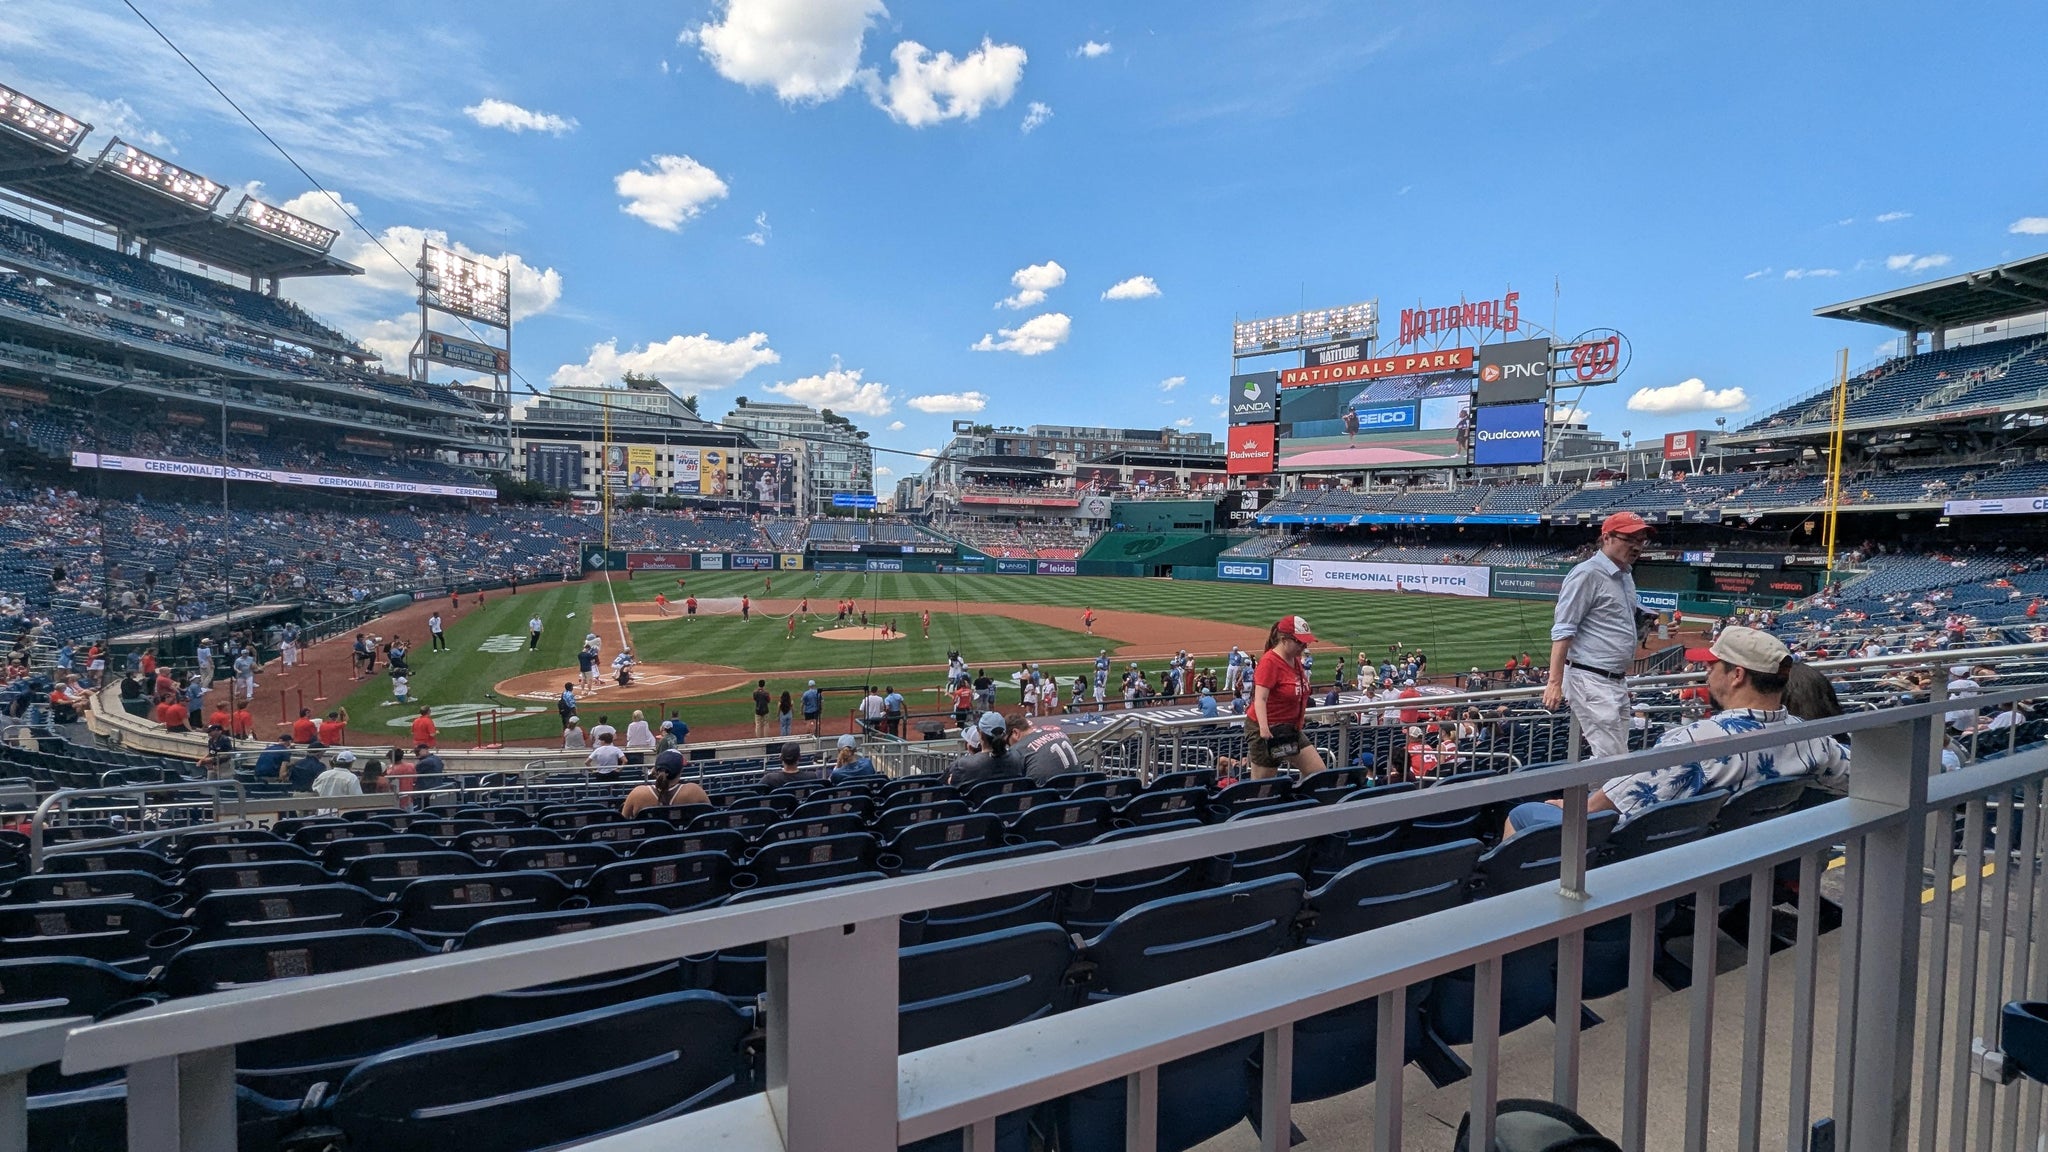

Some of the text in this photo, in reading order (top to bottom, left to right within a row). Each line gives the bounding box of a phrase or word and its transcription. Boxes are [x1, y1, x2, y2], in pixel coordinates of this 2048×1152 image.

[1400, 291, 1519, 345] NATIONALS
[1320, 345, 1360, 364] NATITUDE
[1287, 353, 1460, 383] NATIONALS PARK
[1503, 362, 1545, 379] PNC
[1233, 402, 1271, 412] VANDA
[1478, 429, 1541, 441] Qualcomm
[1230, 450, 1270, 459] Budweiser
[145, 461, 272, 481] CEREMONIAL FIRST PITCH
[318, 477, 417, 492] CEREMONIAL FIRST PITCH
[455, 487, 497, 497] CEREMONIAL
[746, 556, 769, 564] Inova
[879, 561, 900, 570] Terra
[1049, 564, 1075, 573] leidos
[1223, 565, 1262, 576] GEICO
[1325, 571, 1466, 586] CEREMONIAL FIRST PITCH
[1499, 579, 1535, 588] VENTURE
[1769, 582, 1803, 591] verizon
[1642, 596, 1676, 606] DABOS
[1050, 740, 1079, 769] 11
